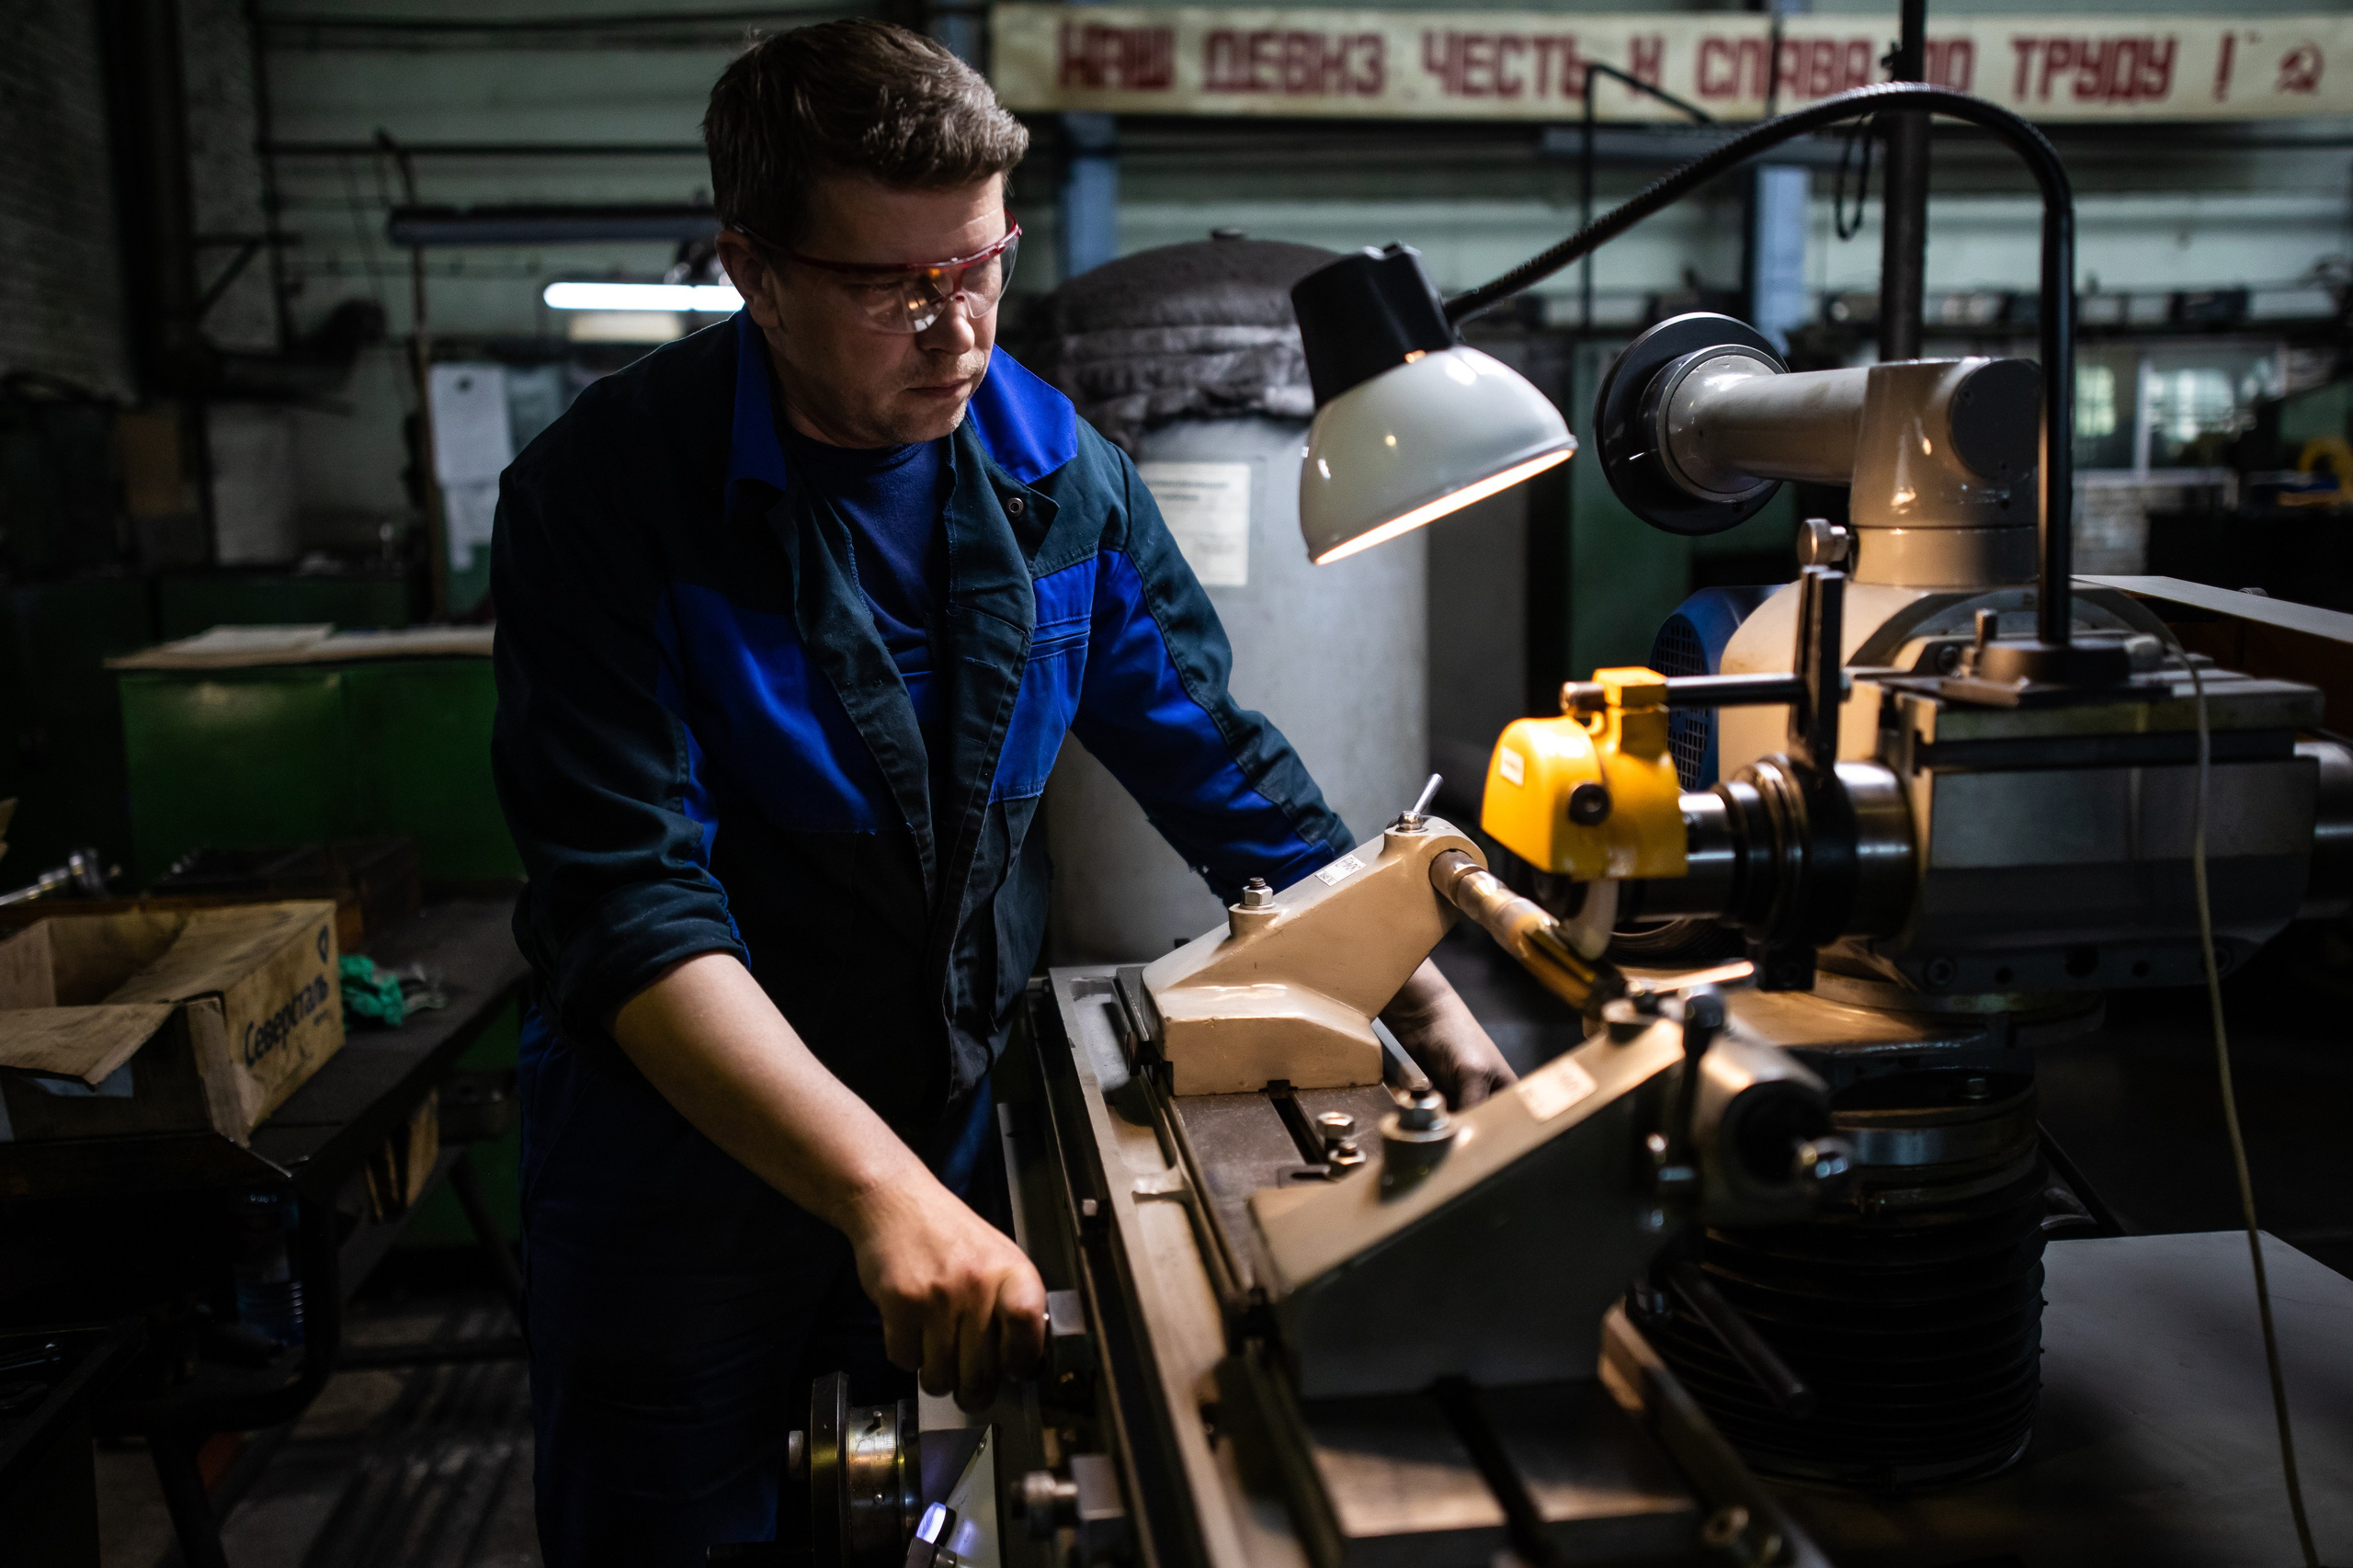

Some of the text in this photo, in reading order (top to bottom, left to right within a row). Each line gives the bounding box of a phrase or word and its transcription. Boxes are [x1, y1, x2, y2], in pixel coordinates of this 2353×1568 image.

[1060, 24, 1176, 90] НАШ
[1201, 29, 1384, 97] ДЕВИЗ
[1422, 32, 1588, 98] ЧЕСТЬ
[1697, 38, 1872, 98] СЛАВА
[2012, 36, 2177, 102] ТРУДУ
[244, 975, 328, 1067] Северсталь
